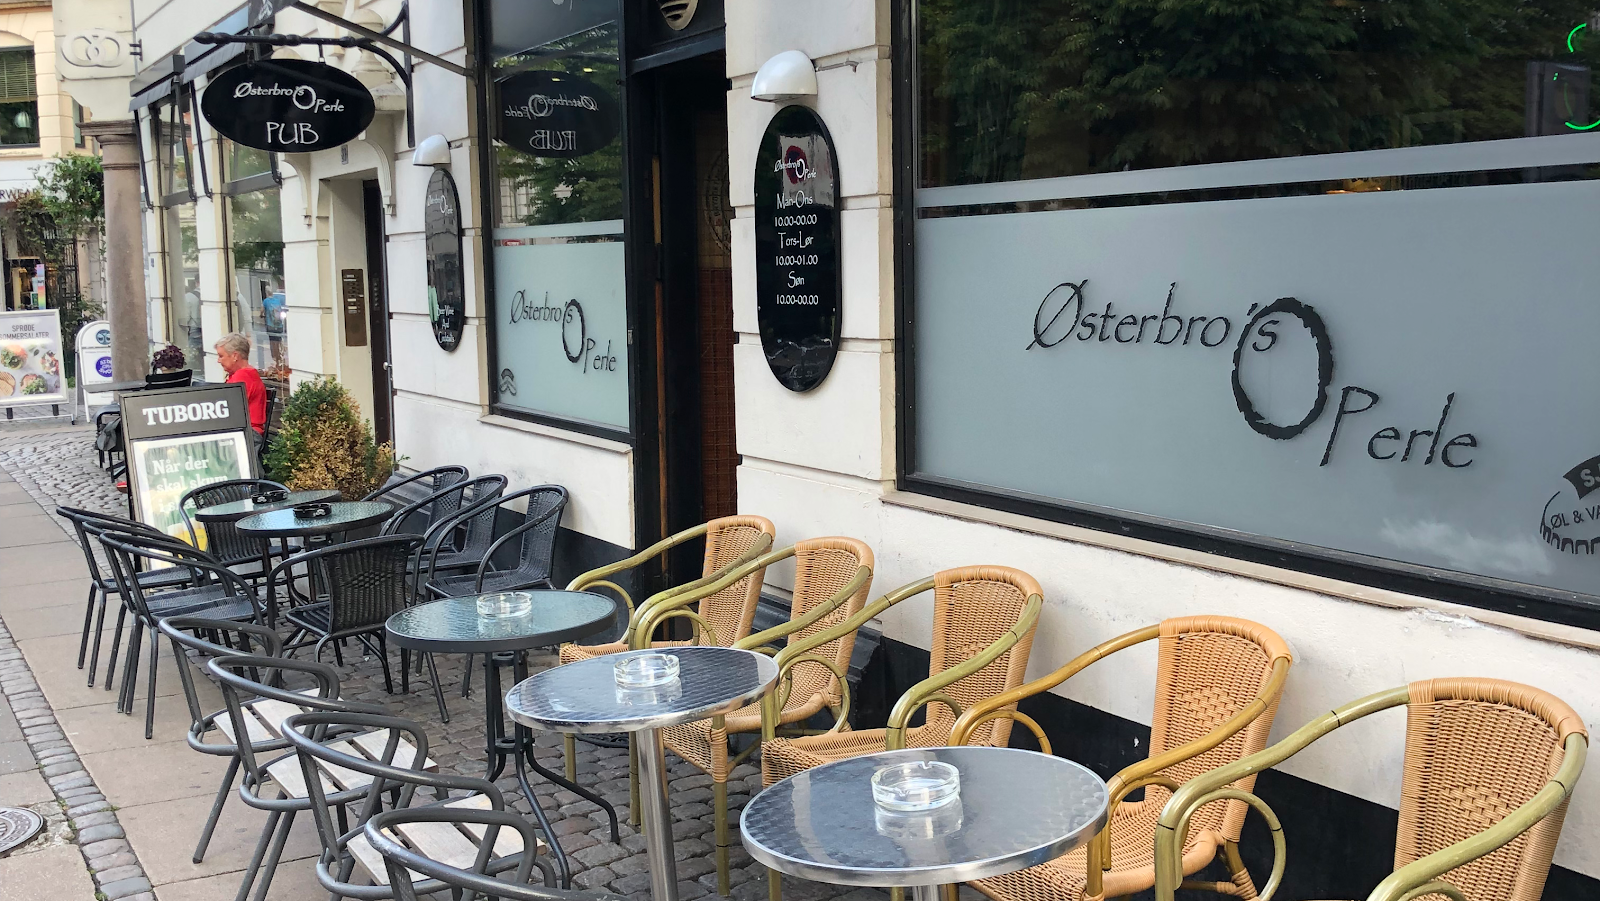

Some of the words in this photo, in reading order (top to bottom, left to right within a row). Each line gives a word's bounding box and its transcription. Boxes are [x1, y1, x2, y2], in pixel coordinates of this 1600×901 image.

[233, 82, 304, 98] Østerbro's
[314, 99, 345, 113] Perle
[266, 121, 319, 145] PUB
[775, 213, 818, 227] 10.00-00.00
[777, 231, 814, 249] Tors-Lør
[775, 254, 818, 266] 10.00-01.00
[787, 270, 805, 288] Søn
[776, 294, 819, 305] 10.00-00.00
[509, 289, 573, 325] Østerbro's
[583, 338, 616, 374] Perle
[1026, 279, 1280, 351] Østerbro's
[1320, 385, 1478, 467] Perle
[142, 400, 230, 426] TUBORG
[152, 459, 180, 475] Når
[185, 456, 209, 471] der
[157, 475, 187, 492] skal
[1550, 513, 1570, 530] ØL
[1572, 510, 1584, 523] &
